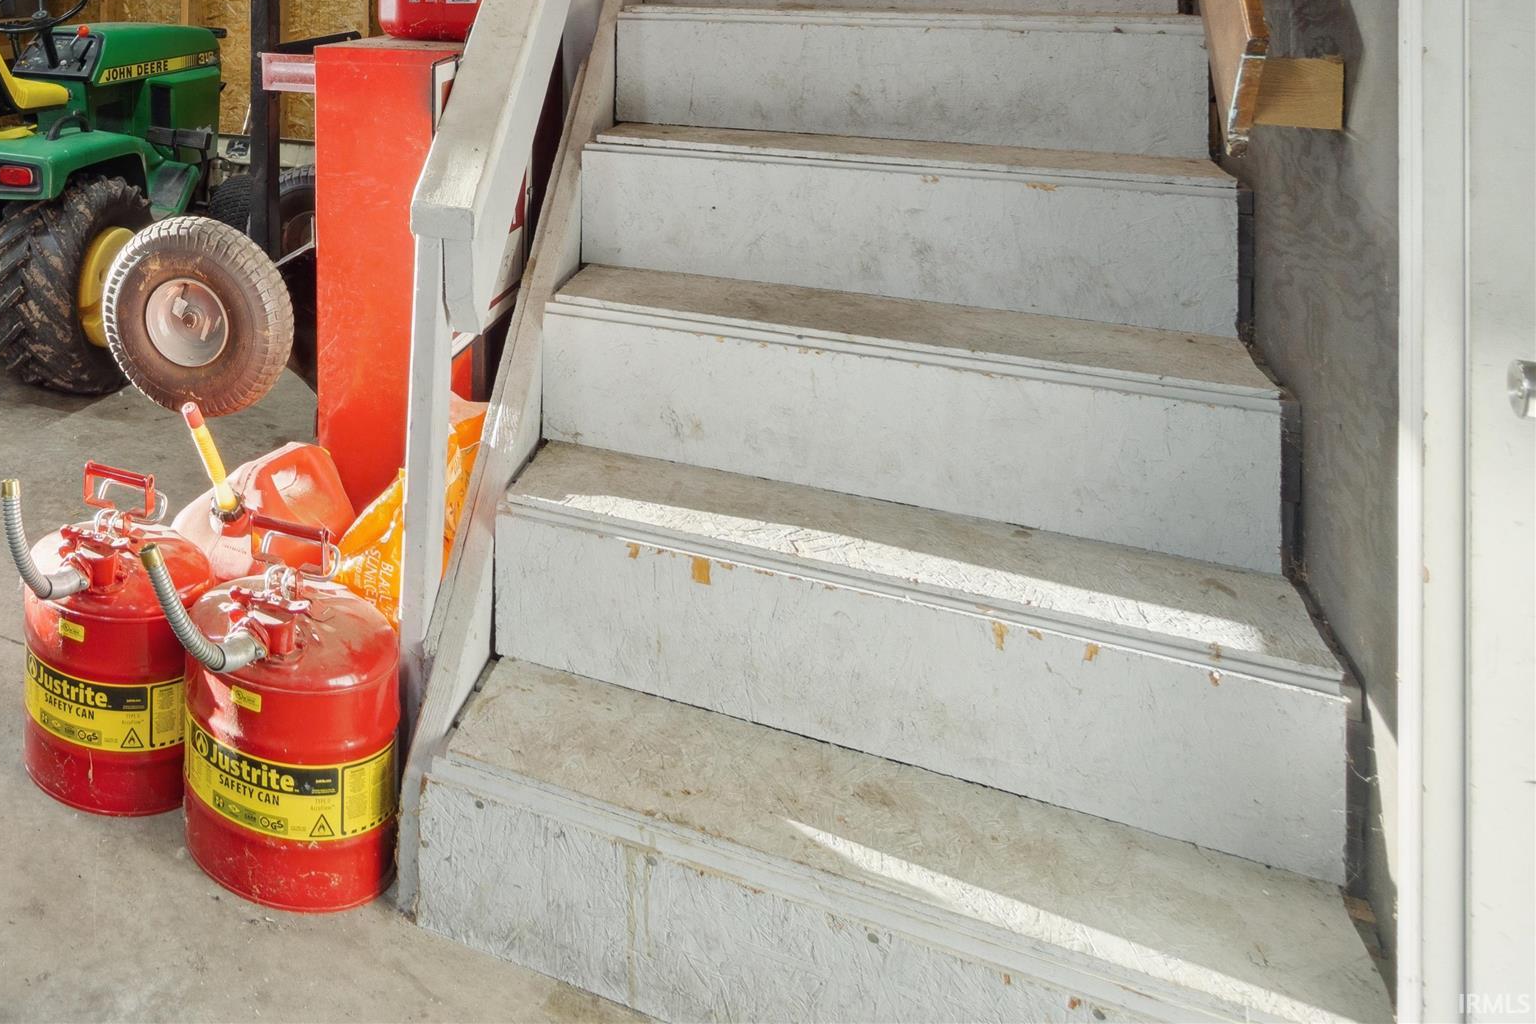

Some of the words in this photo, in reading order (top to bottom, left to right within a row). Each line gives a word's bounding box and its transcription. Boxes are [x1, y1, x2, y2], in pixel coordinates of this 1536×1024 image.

[105, 65, 133, 82] JOHN
[136, 60, 169, 76] DEERE
[37, 666, 109, 709] Justrite
[44, 692, 74, 715] SAFETY
[75, 707, 95, 721] CAN
[209, 744, 295, 792] Justrite
[218, 774, 254, 800] SAFETY
[257, 790, 280, 807] CAN
